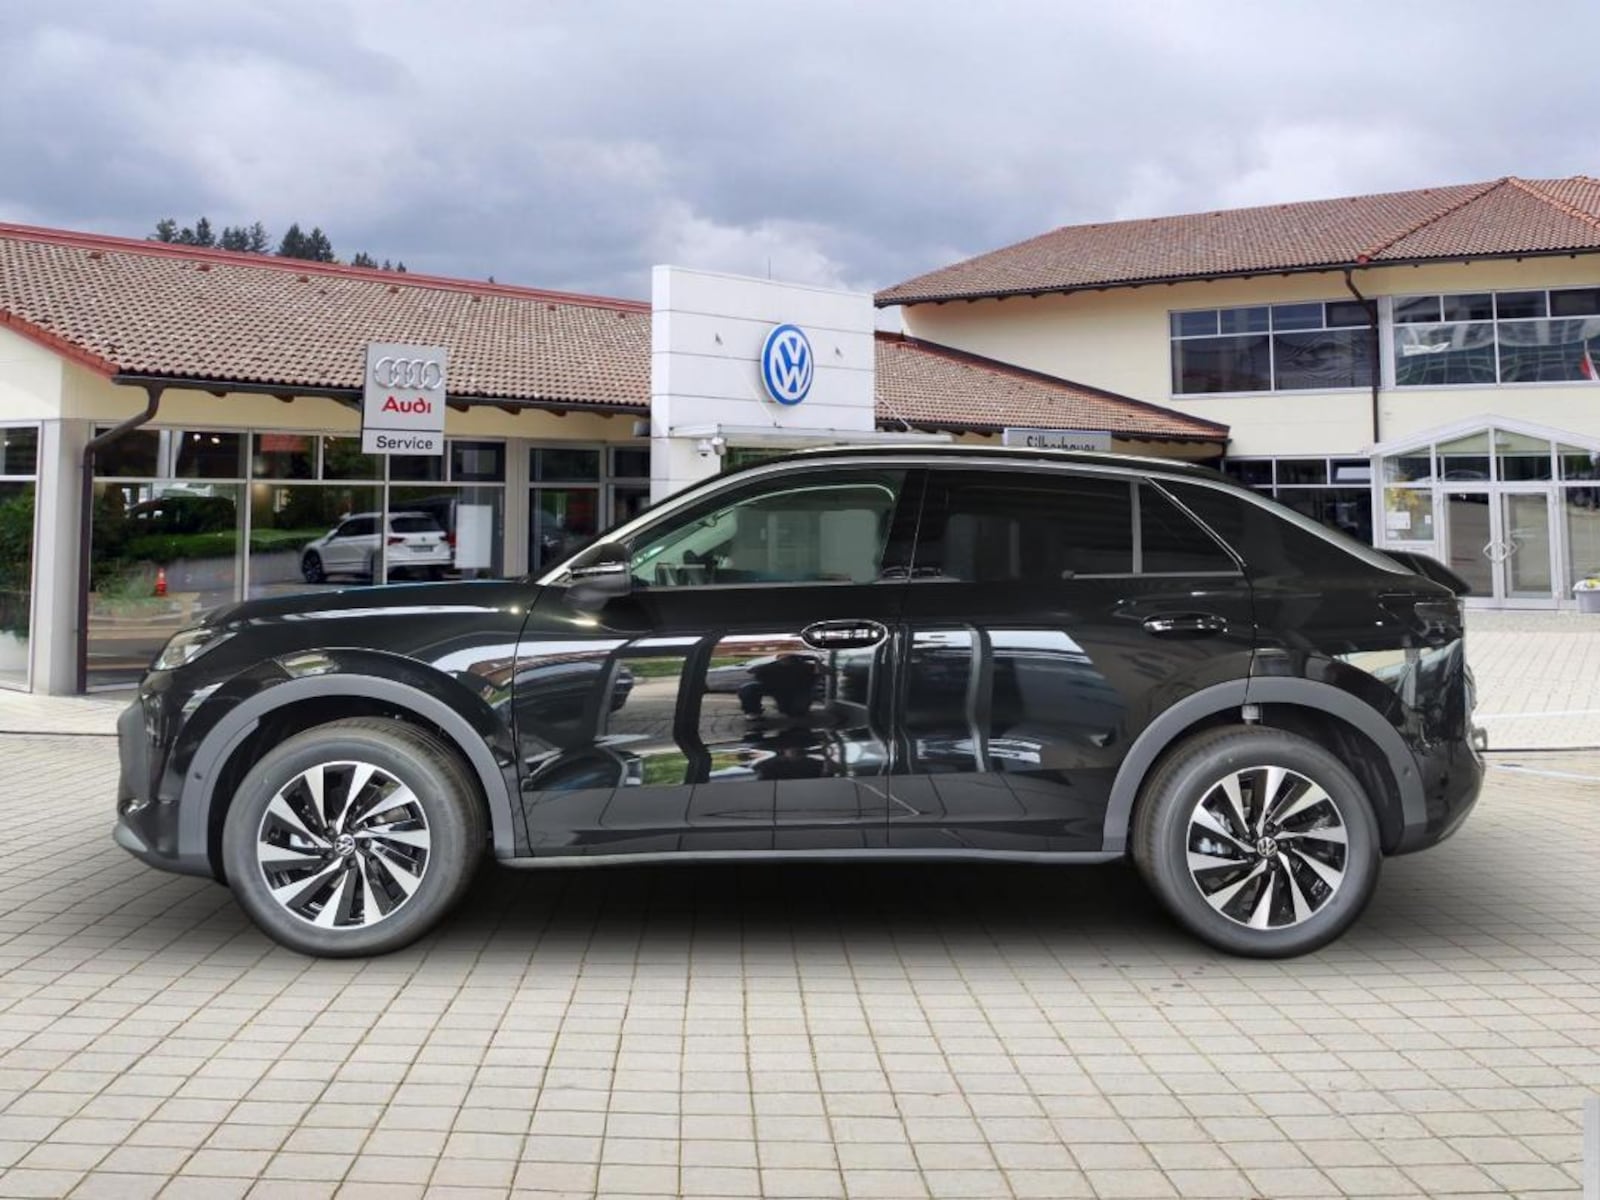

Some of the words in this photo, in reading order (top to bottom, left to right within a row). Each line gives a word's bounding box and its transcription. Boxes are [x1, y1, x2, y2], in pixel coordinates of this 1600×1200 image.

[766, 328, 811, 401] VW
[381, 395, 432, 414] Audi
[376, 435, 434, 450] Service
